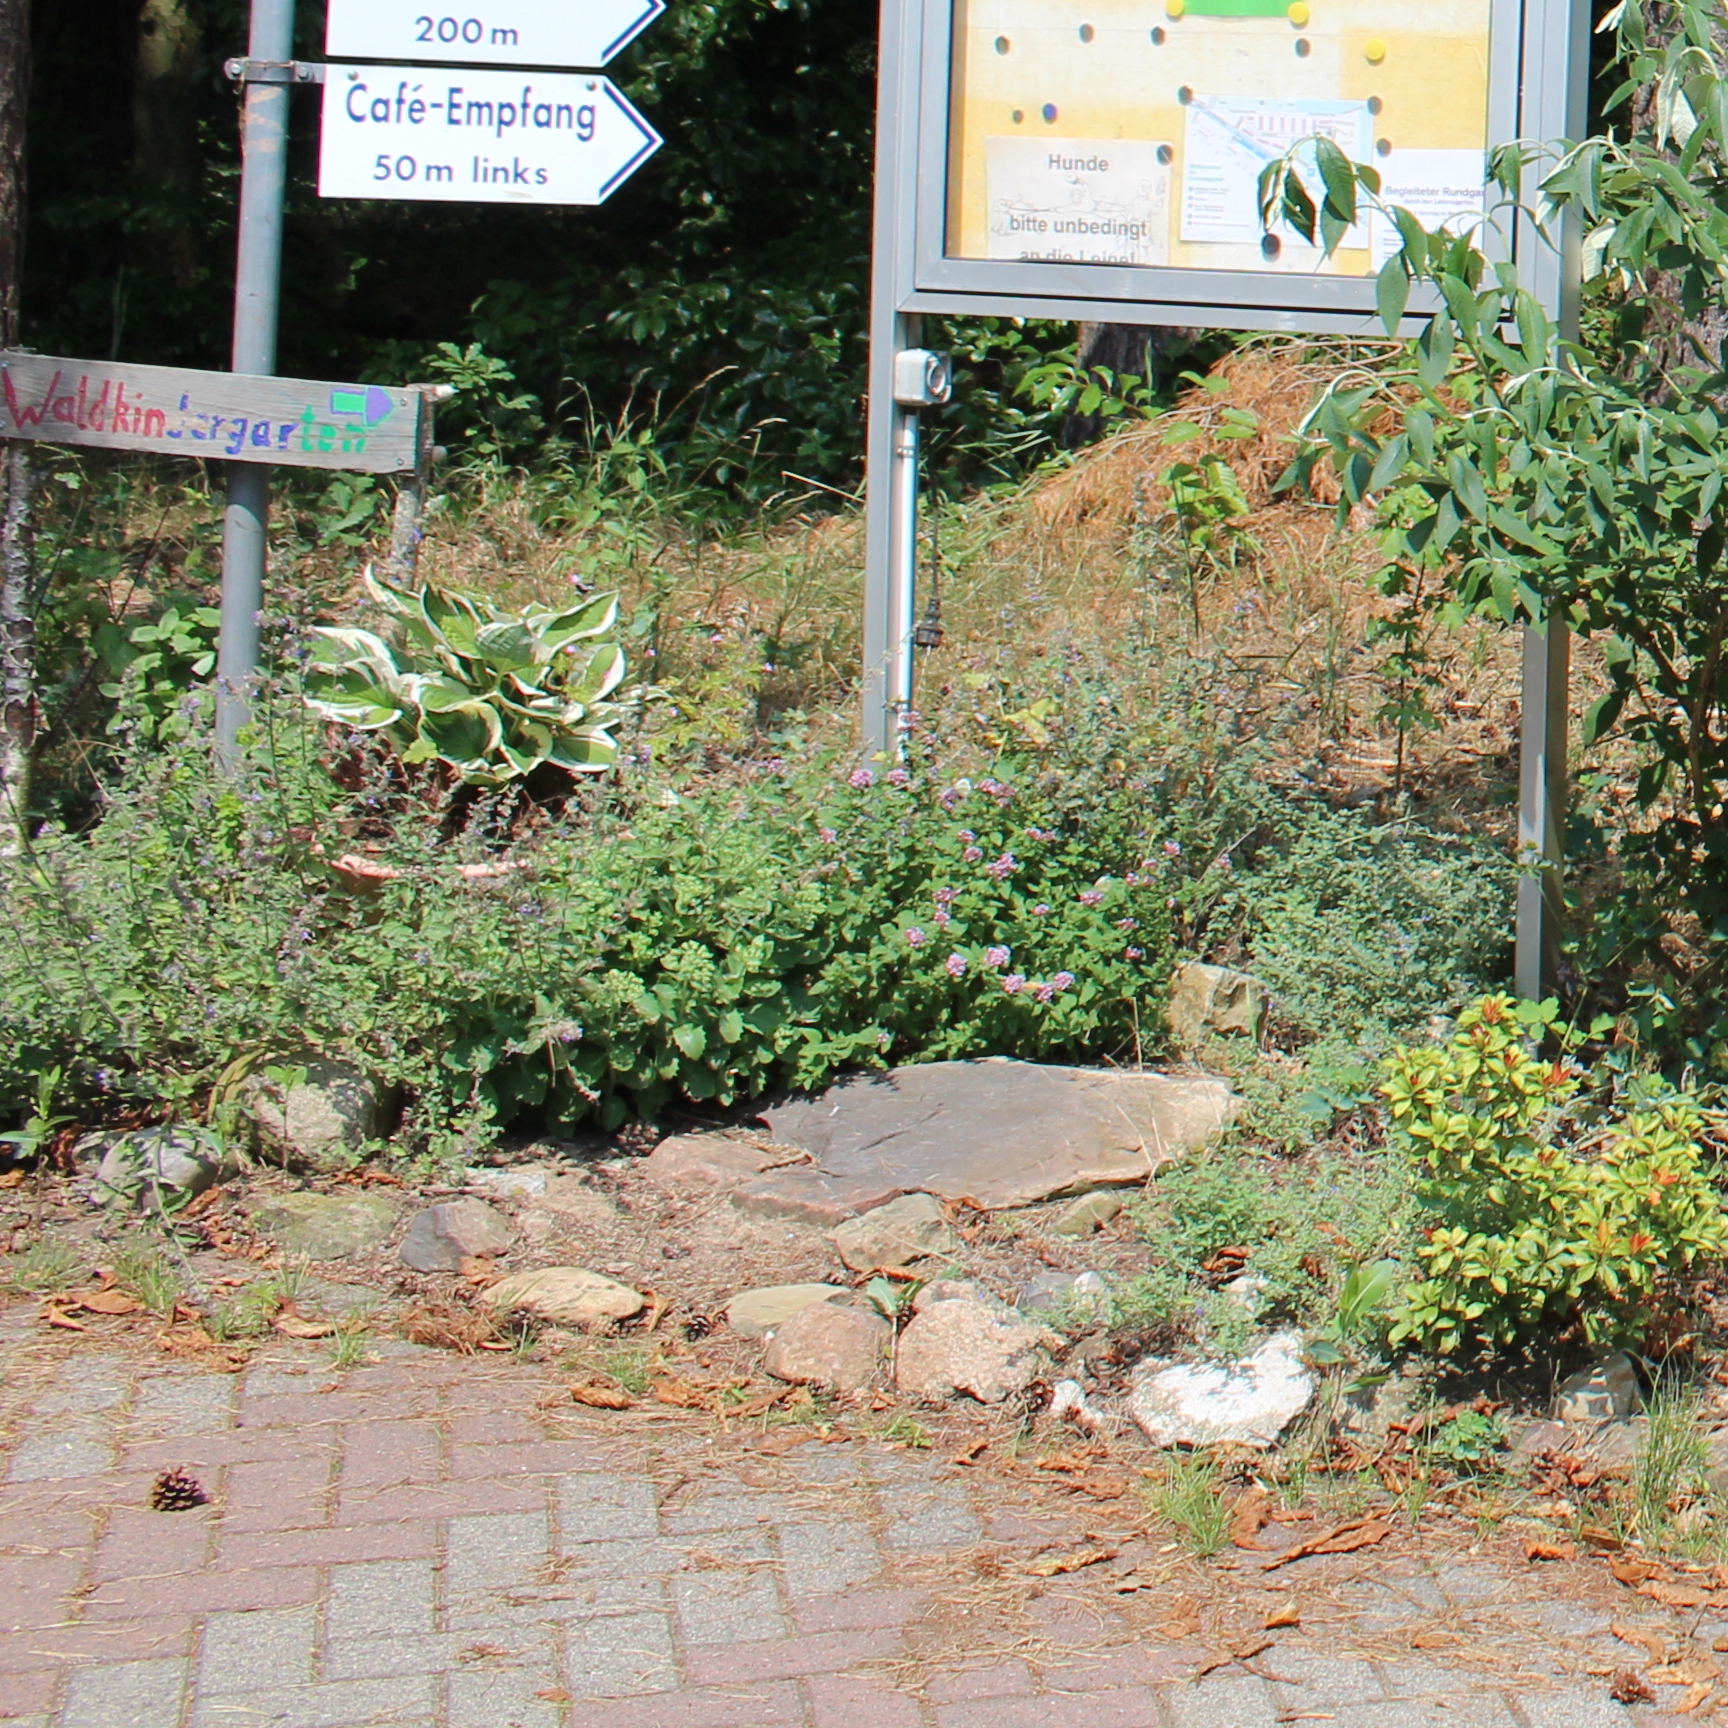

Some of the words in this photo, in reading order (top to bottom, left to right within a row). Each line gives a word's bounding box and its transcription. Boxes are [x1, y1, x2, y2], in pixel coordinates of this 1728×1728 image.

[414, 15, 482, 45] 200
[490, 24, 519, 46] m
[346, 83, 596, 141] Café-Empfang
[373, 154, 423, 182] 50
[427, 162, 453, 184] m
[473, 155, 548, 186] links
[1048, 154, 1109, 172] Hunde
[1009, 215, 1048, 232] bitte
[1053, 217, 1148, 240] unbedingt
